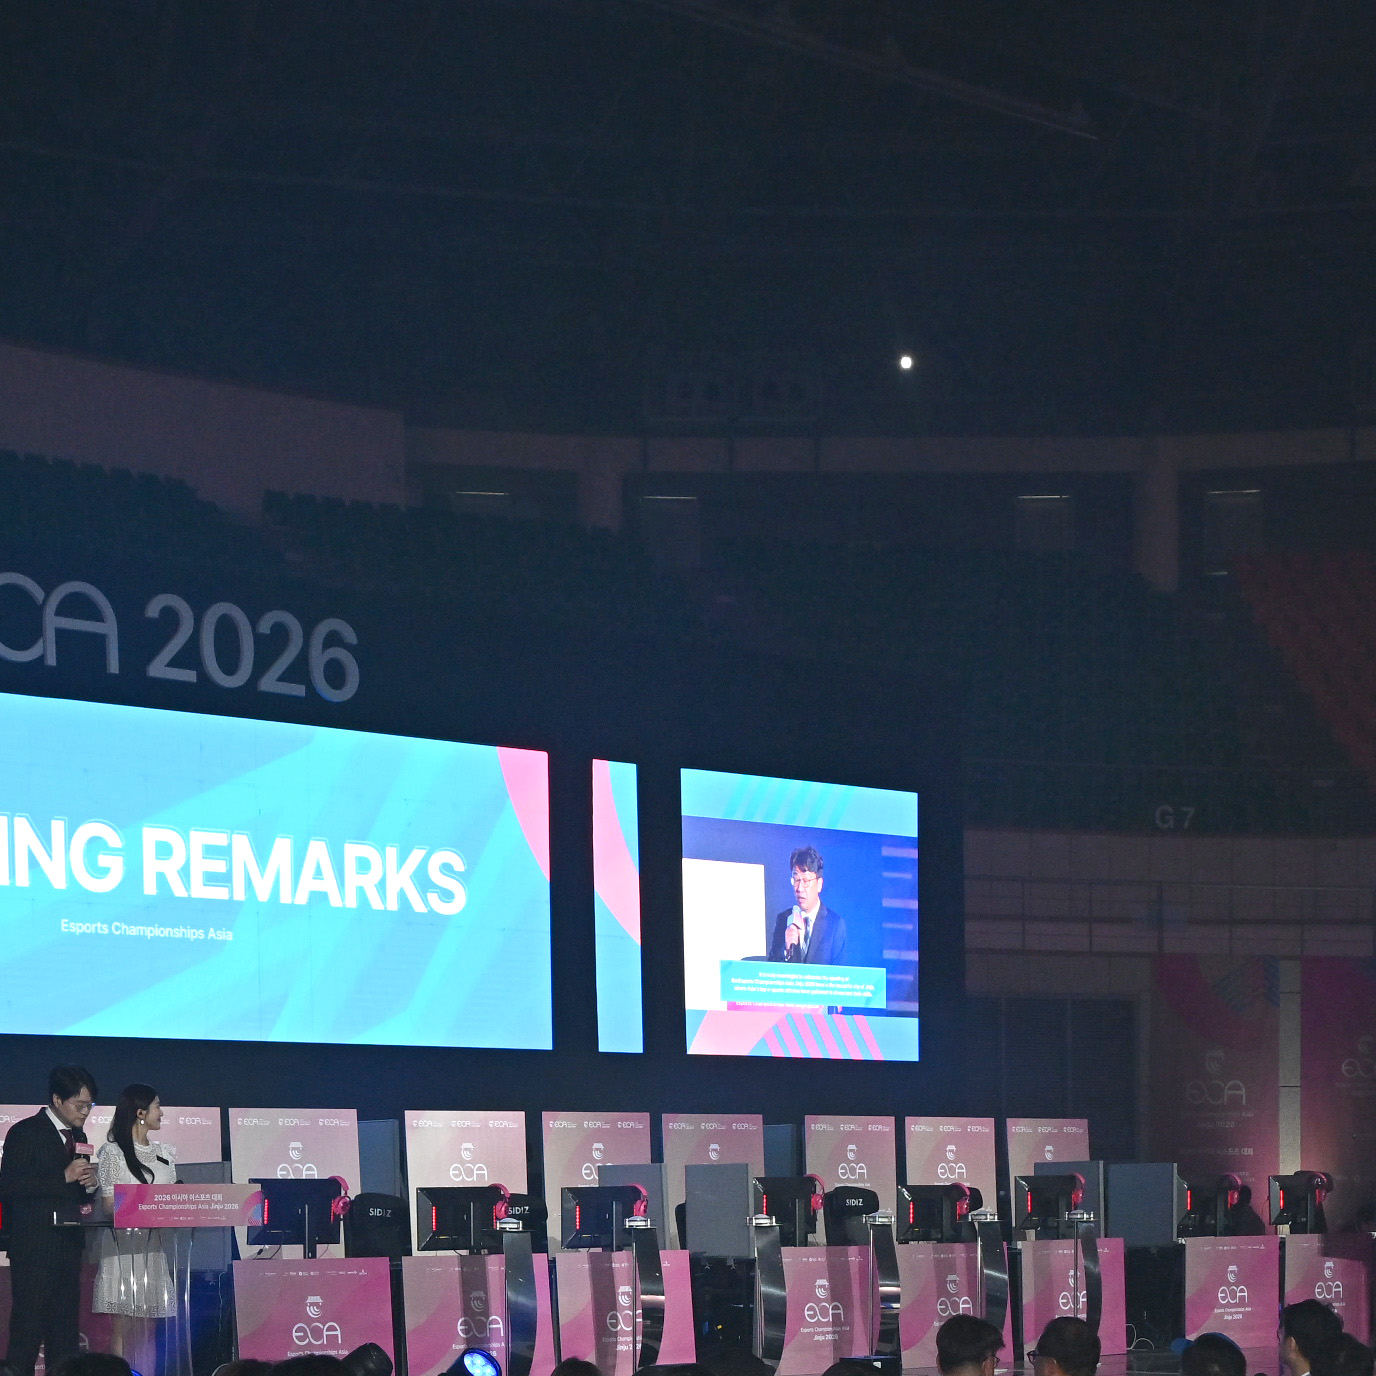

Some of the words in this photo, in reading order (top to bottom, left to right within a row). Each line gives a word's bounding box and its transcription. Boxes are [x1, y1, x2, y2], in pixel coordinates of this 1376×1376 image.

[145, 594, 359, 702] 2026
[142, 825, 468, 915] REMARKS
[61, 919, 108, 937] Esports
[111, 921, 204, 940] Championships
[207, 926, 233, 941] Asia
[1187, 1080, 1246, 1106] ECA
[277, 1163, 318, 1179] ECA
[449, 1164, 488, 1181] ECA
[838, 1163, 867, 1179] ECA
[937, 1163, 967, 1179] ECA
[138, 1203, 157, 1211] Esports
[158, 1203, 197, 1211] Championships
[508, 1206, 530, 1215] SIDIZ
[846, 1198, 863, 1206] SIDIZ
[369, 1207, 392, 1218] SIDIZ
[1218, 1285, 1248, 1304] ECA
[1315, 1281, 1343, 1298] ECA
[804, 1302, 844, 1322] ECA
[937, 1297, 973, 1316] ECA
[292, 1322, 341, 1346] ECA
[457, 1315, 504, 1338] ECA
